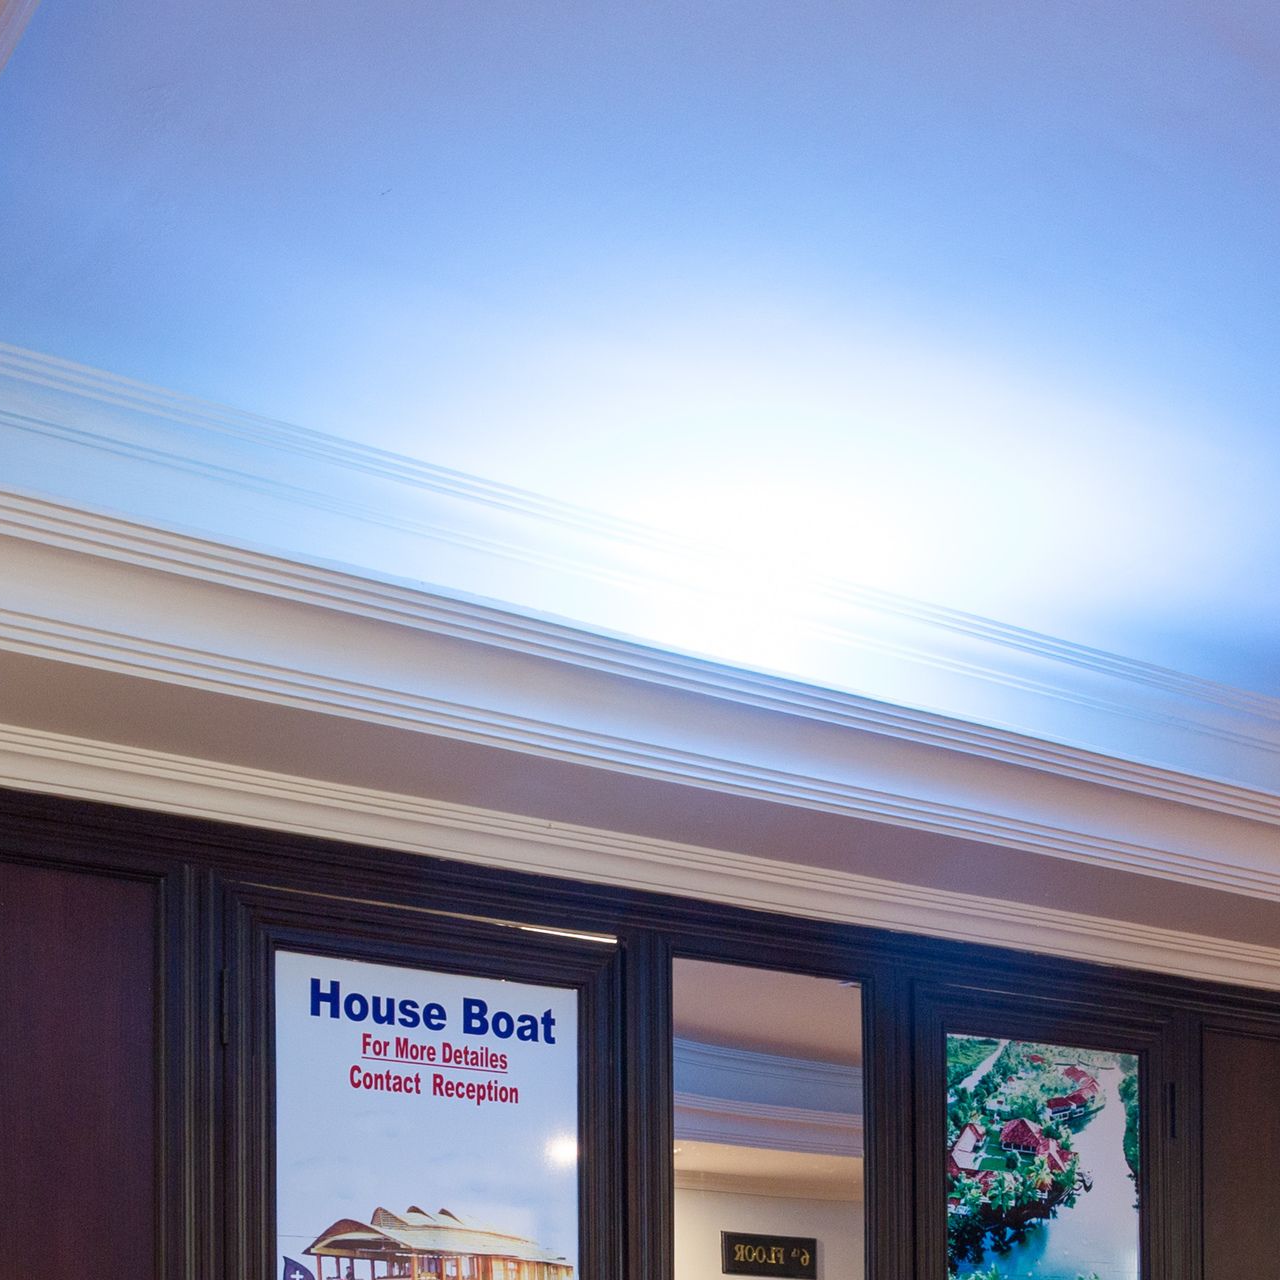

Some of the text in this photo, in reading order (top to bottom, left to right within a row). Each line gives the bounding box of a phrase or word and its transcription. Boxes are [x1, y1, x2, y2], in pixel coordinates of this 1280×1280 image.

[310, 977, 556, 1044] House Boat
[361, 1033, 508, 1070] For More Detailes
[349, 1065, 519, 1106] Contact Reception
